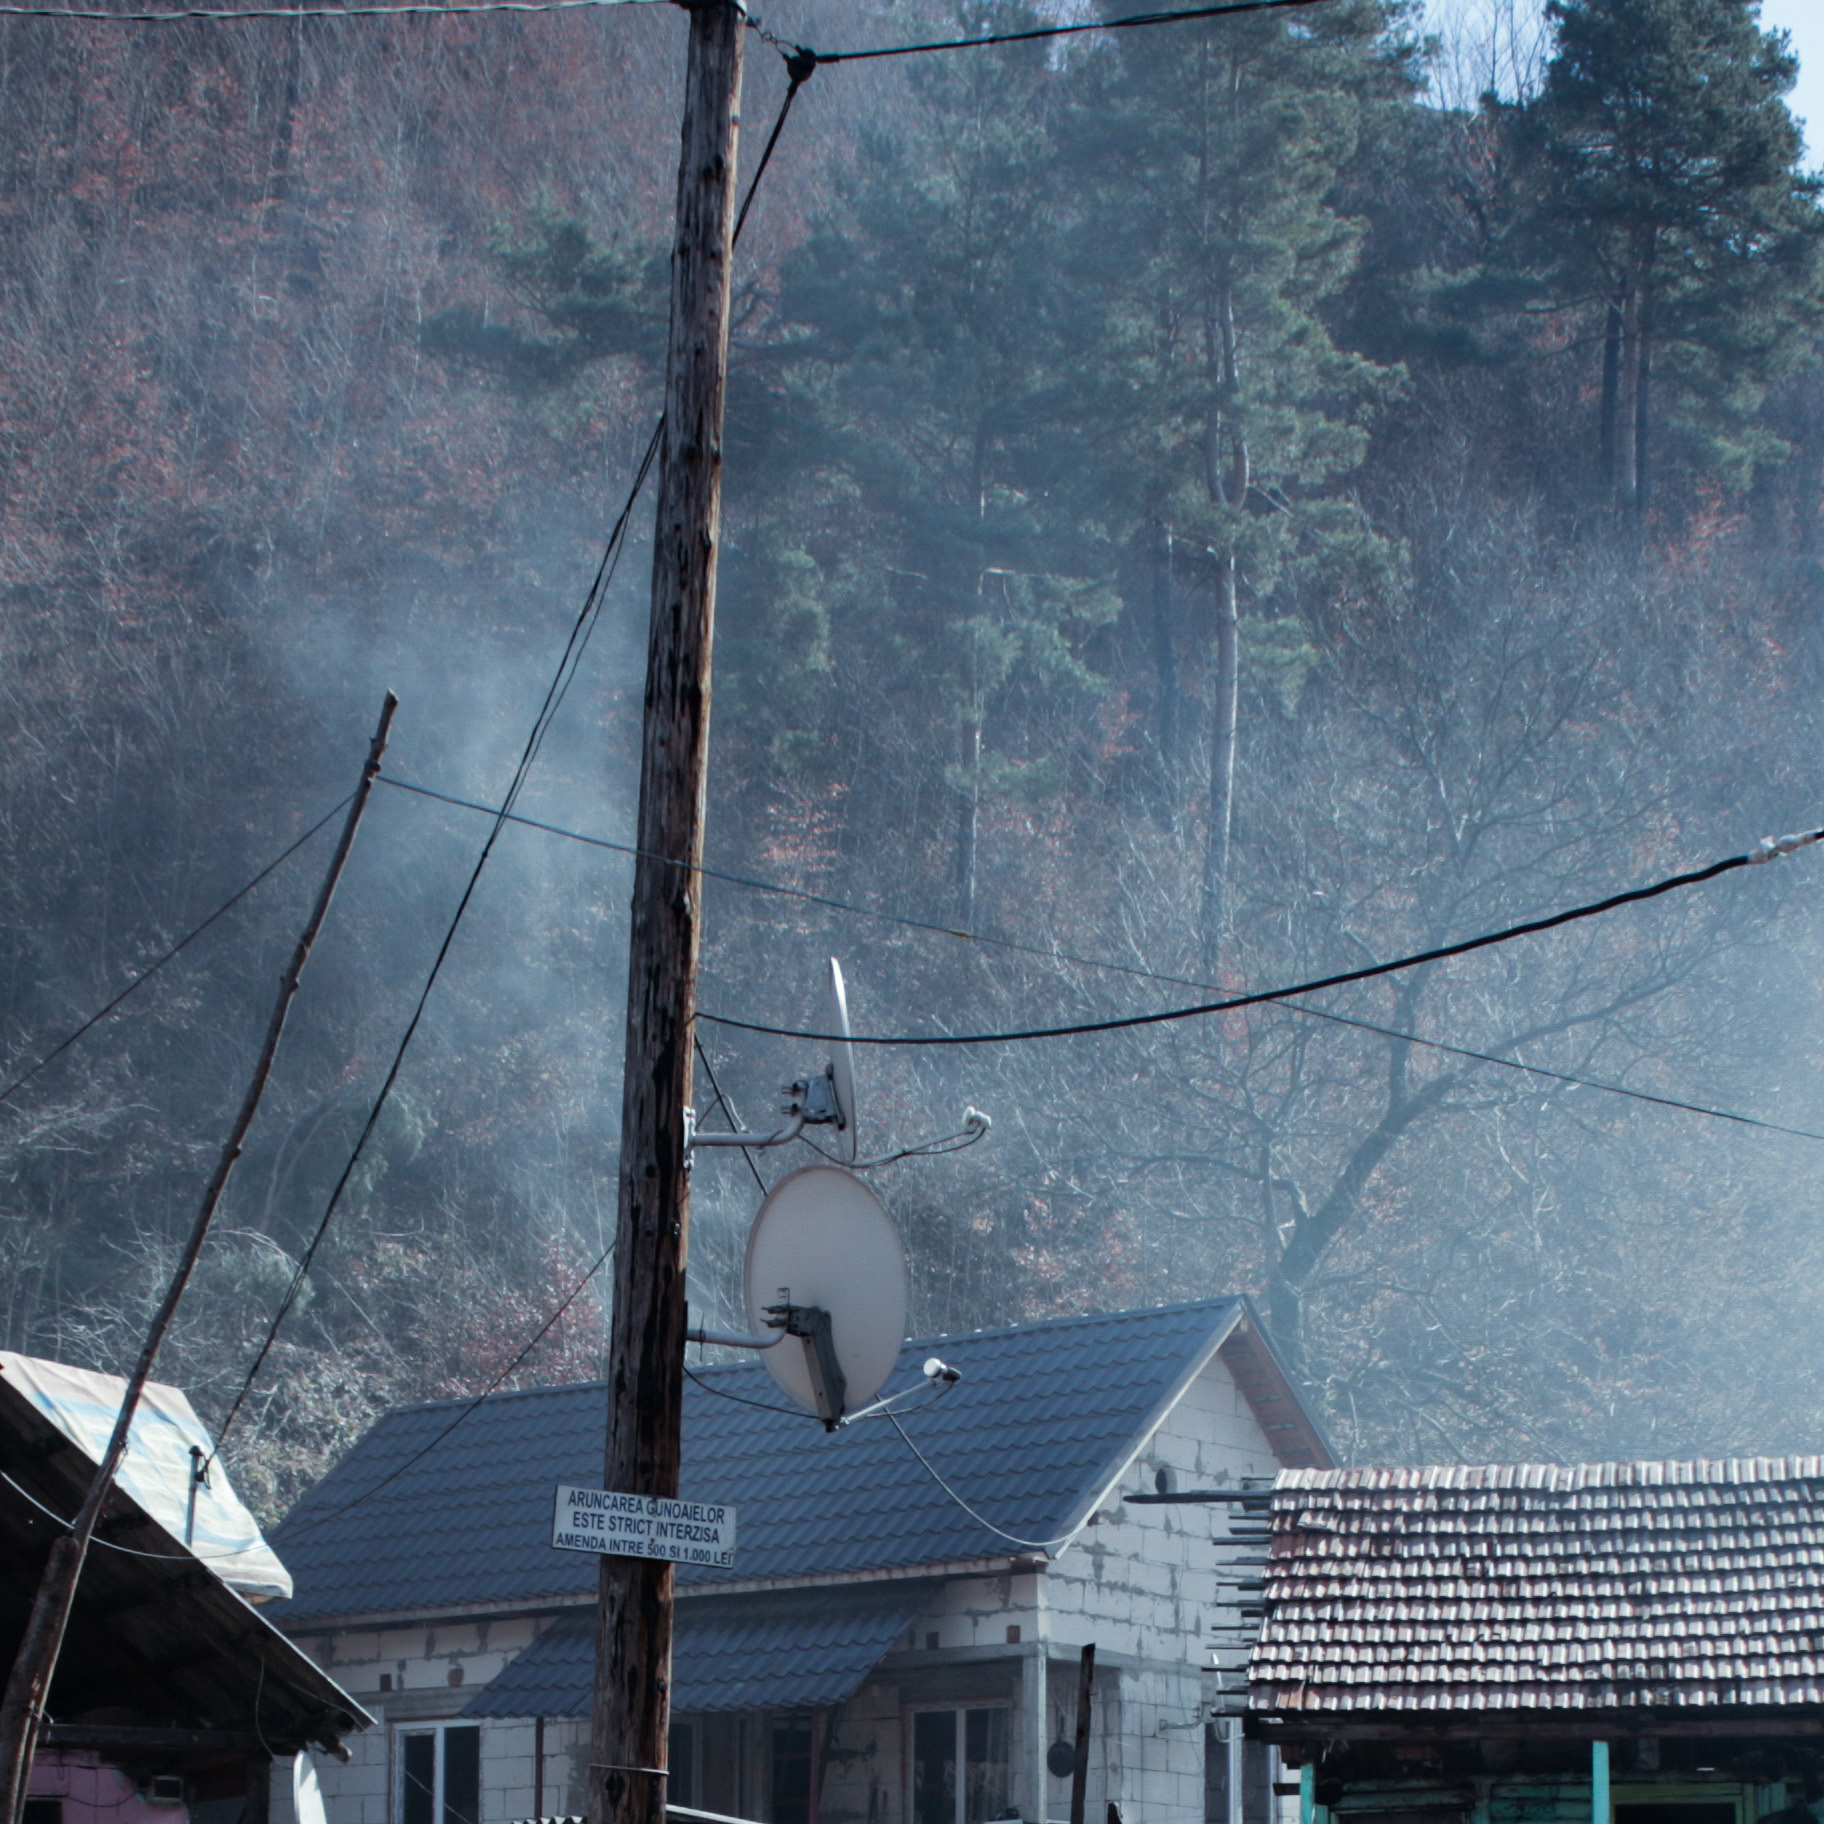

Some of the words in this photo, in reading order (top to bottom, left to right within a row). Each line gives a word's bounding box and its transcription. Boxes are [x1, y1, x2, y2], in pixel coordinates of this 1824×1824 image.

[568, 1490, 643, 1514] ARUNCAREA
[646, 1500, 724, 1524] GUNOAIELOR
[573, 1511, 605, 1530] ESTE
[608, 1515, 653, 1536] STRICT
[657, 1521, 719, 1544] INTERZISA
[556, 1532, 606, 1551] AMENDA
[609, 1538, 643, 1554] INTRE
[647, 1543, 666, 1556] 500
[669, 1545, 680, 1559] SI
[683, 1547, 711, 1563] 1.000
[714, 1551, 734, 1566] LEI
